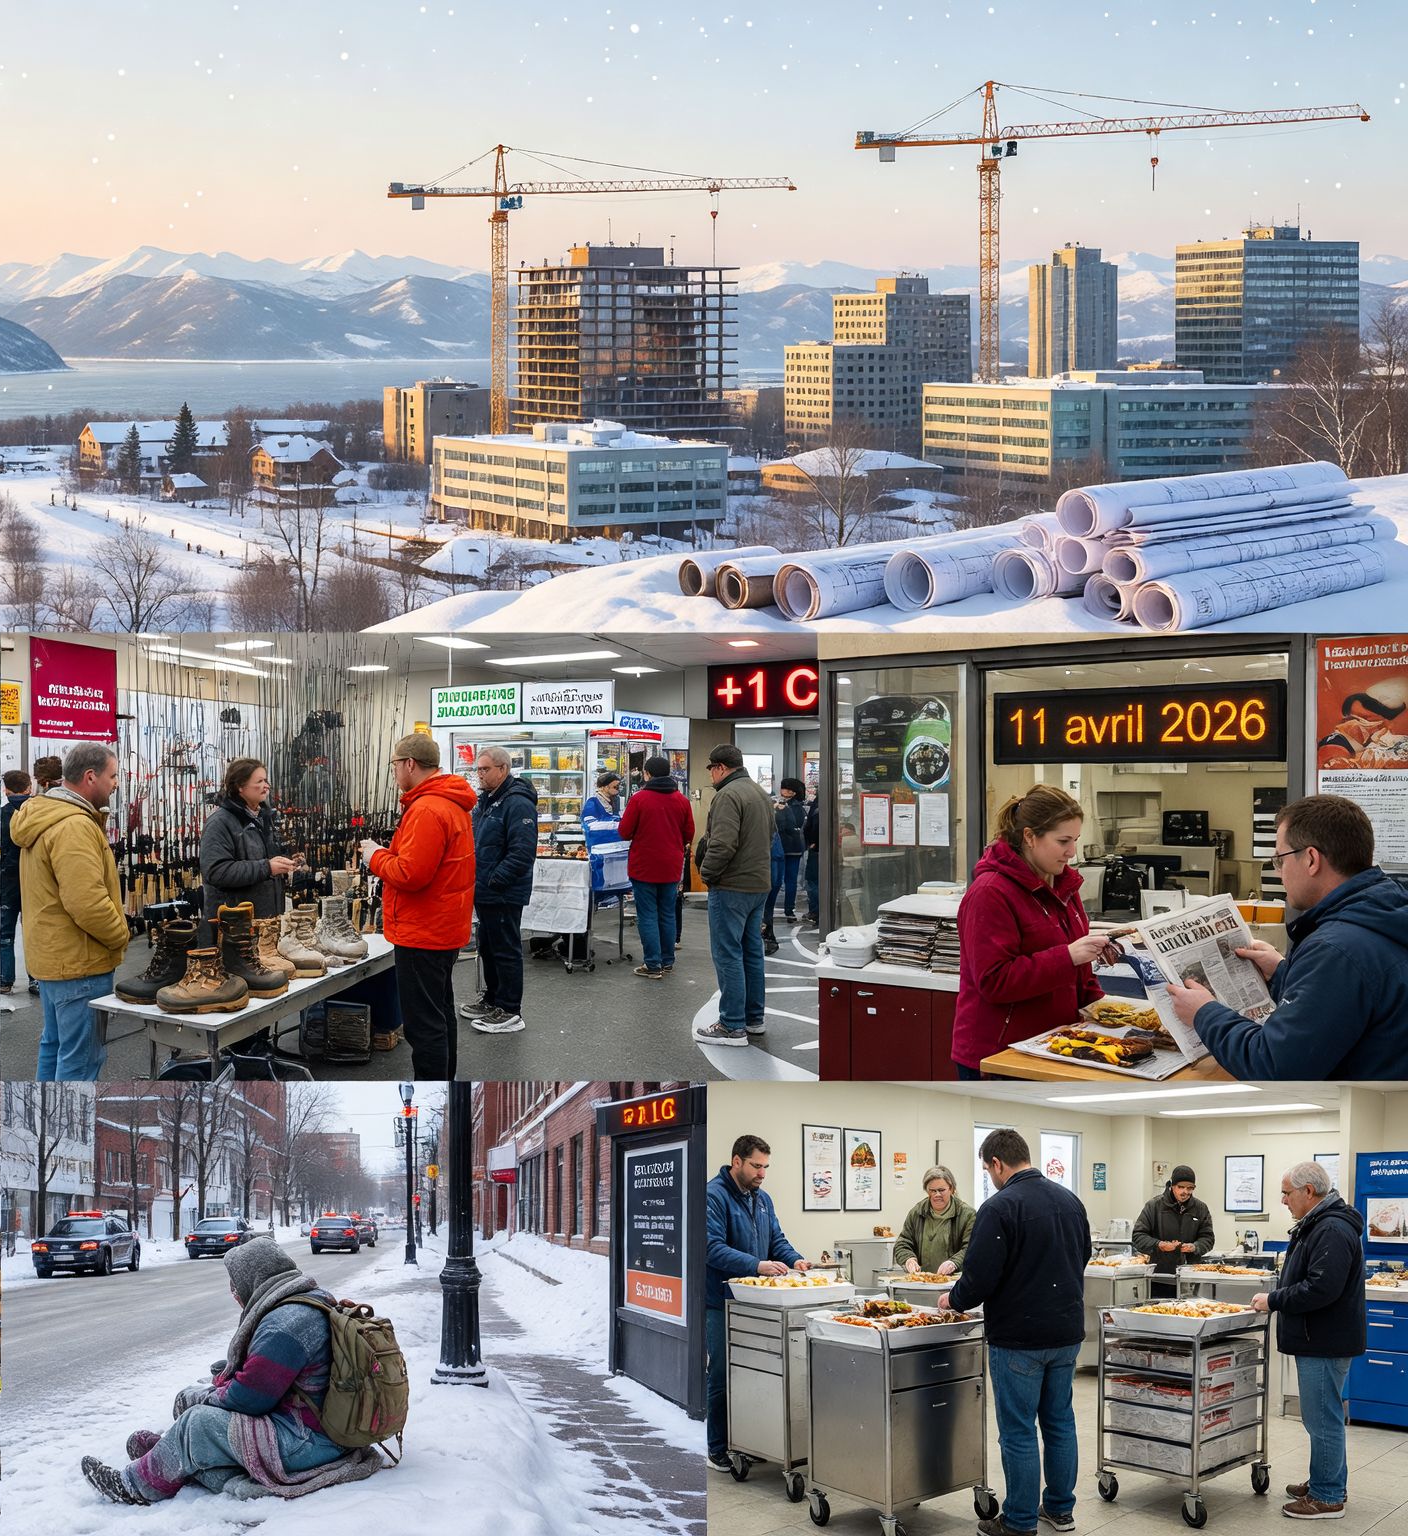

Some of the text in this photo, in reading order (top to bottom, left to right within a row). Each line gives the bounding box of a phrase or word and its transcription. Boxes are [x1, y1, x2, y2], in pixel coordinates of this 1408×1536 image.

[717, 668, 819, 708] +1 C
[1010, 699, 1266, 745] 11 avril 2026
